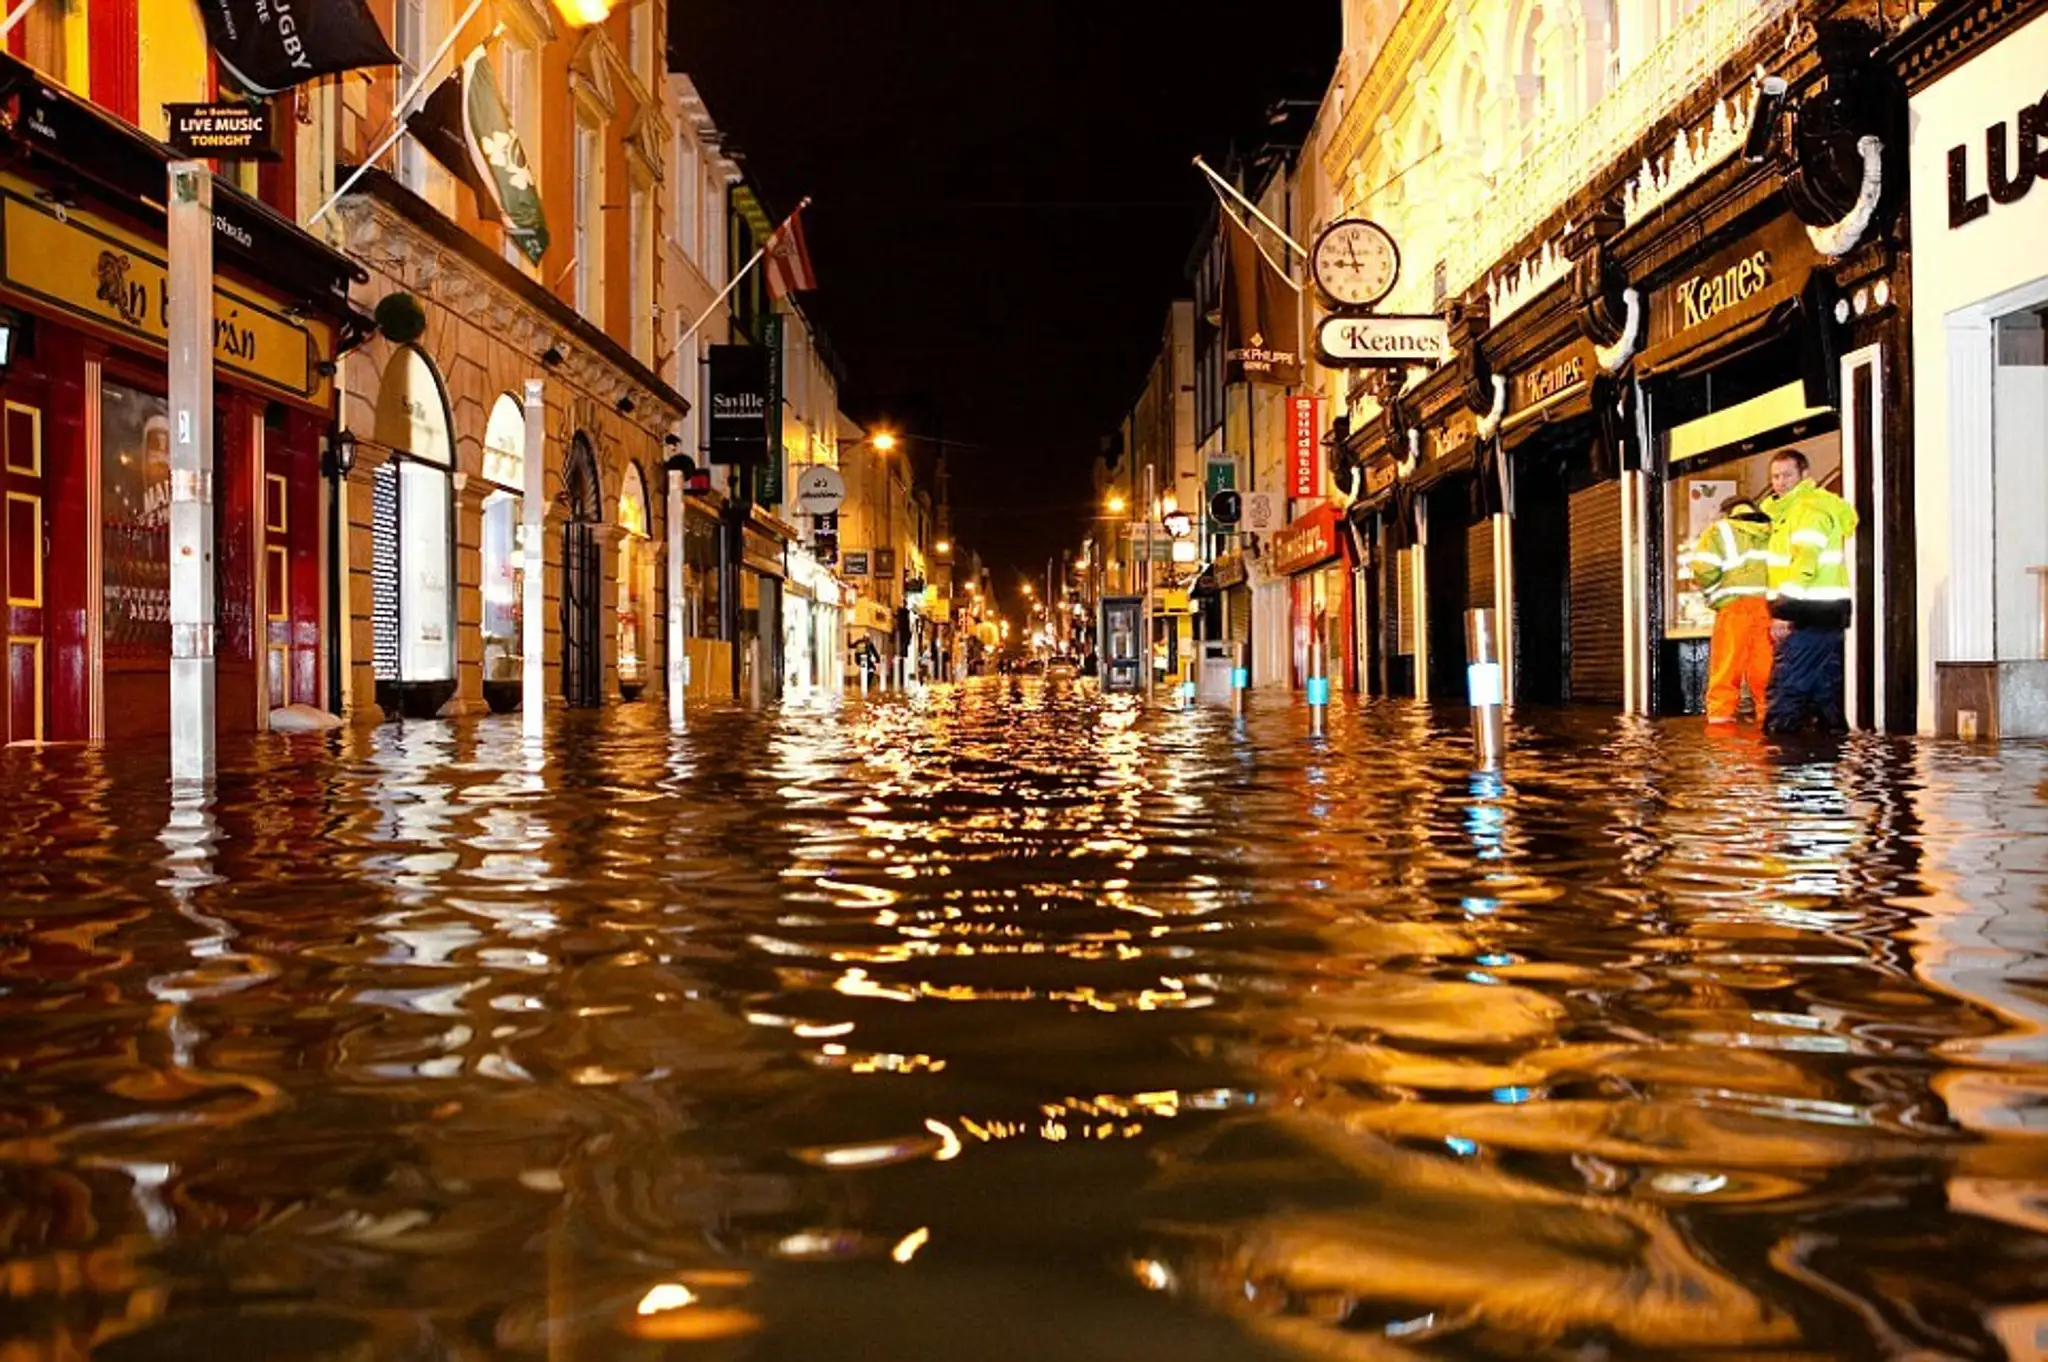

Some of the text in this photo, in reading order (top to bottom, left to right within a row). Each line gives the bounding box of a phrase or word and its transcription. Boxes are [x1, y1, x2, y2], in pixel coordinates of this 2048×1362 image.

[180, 116, 263, 132] LIVE MUSIC
[190, 134, 252, 147] TONIGHT
[1947, 90, 2048, 229] LU
[1676, 250, 1765, 331] Keanes
[1340, 325, 1440, 352] Keanes
[1528, 356, 1581, 402] Keanes
[713, 392, 765, 408] Saville
[1296, 399, 1311, 495] Soundstore
